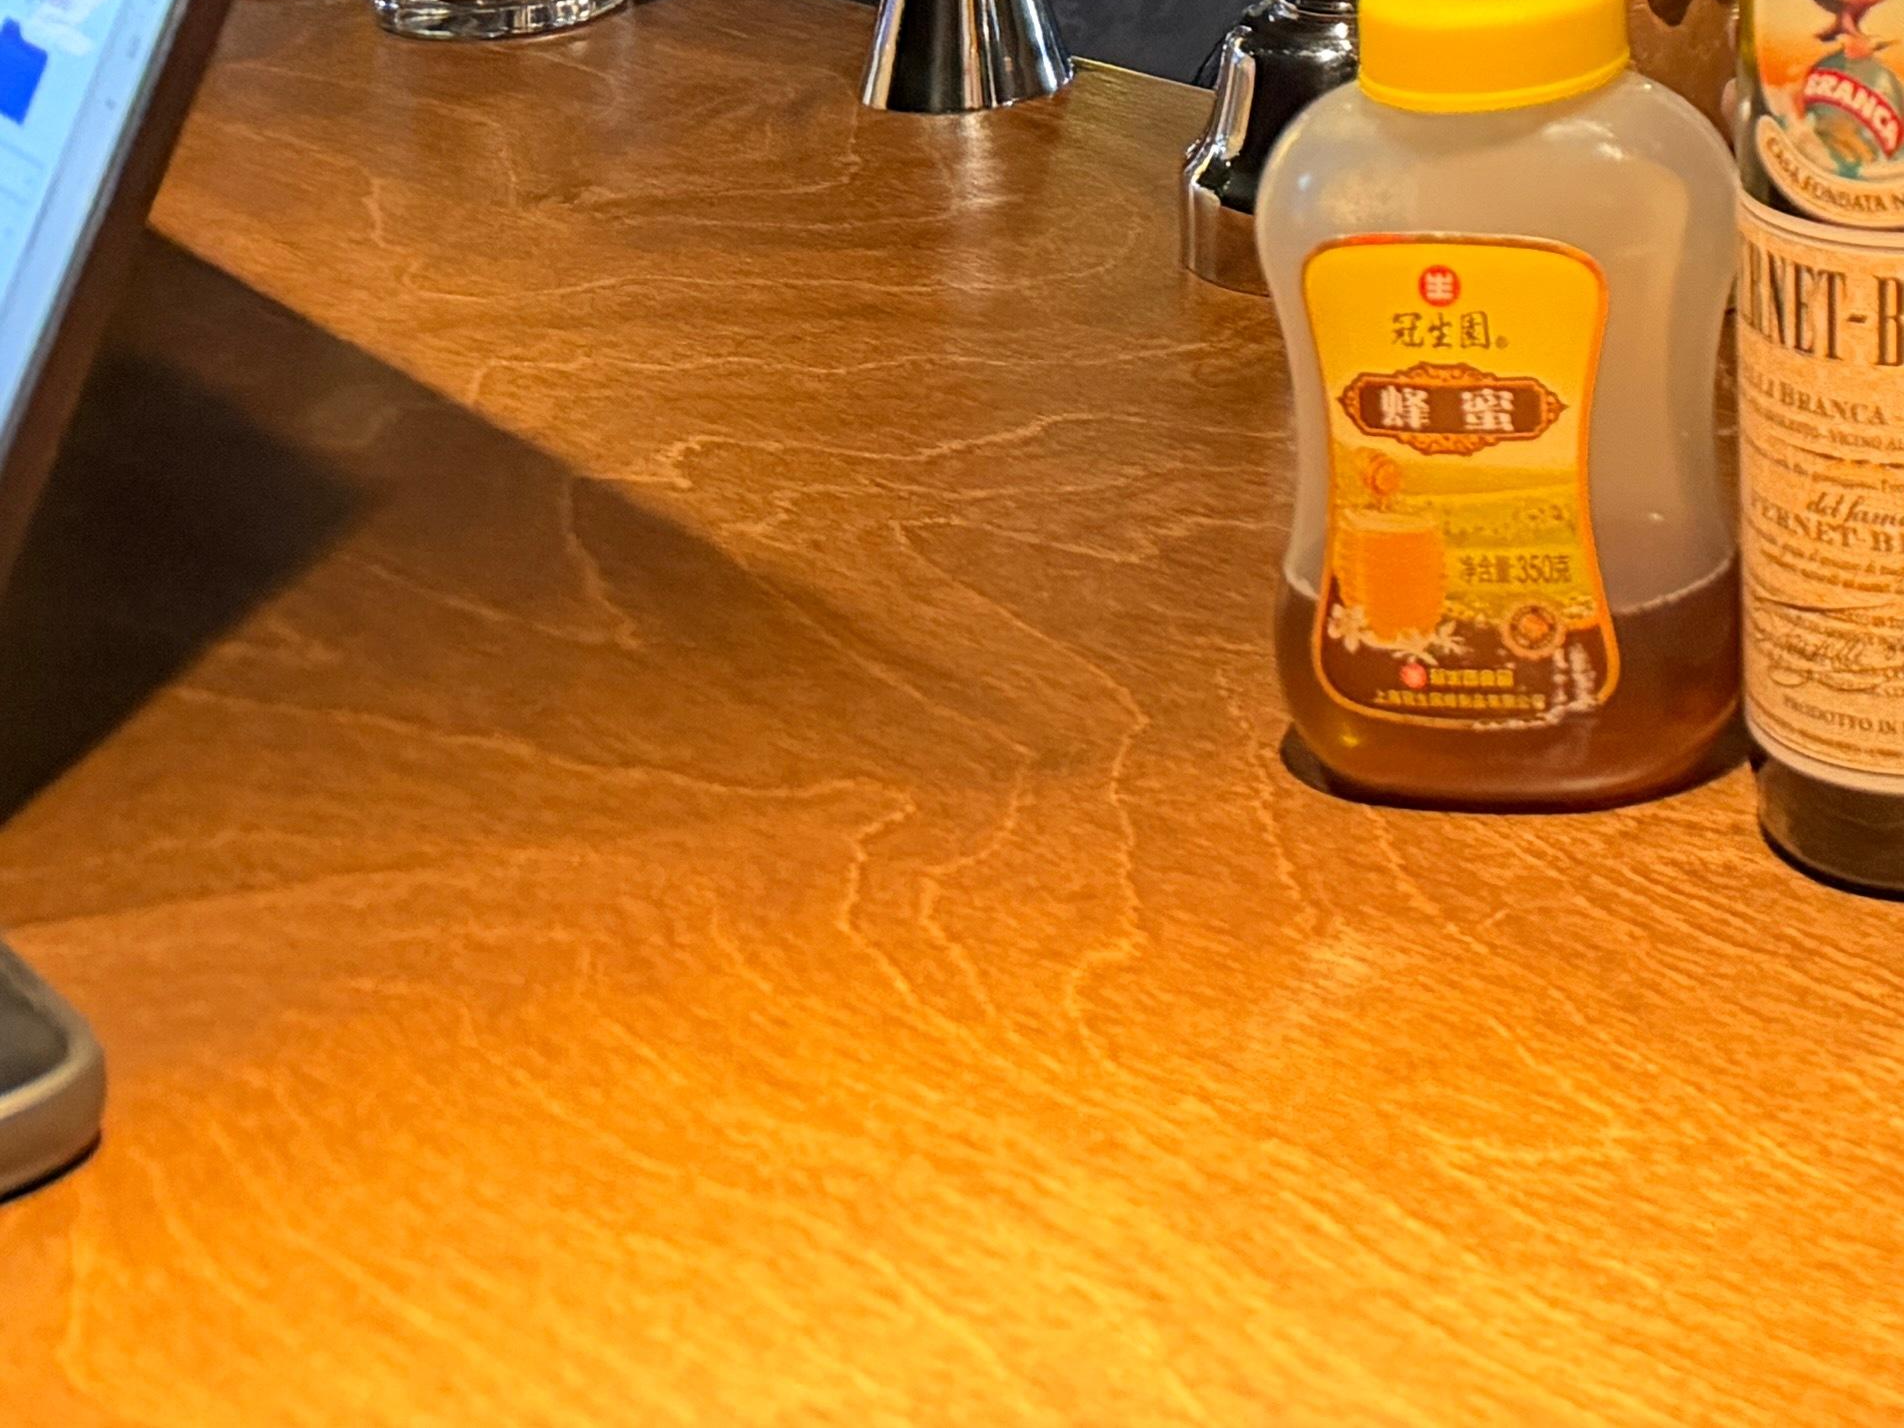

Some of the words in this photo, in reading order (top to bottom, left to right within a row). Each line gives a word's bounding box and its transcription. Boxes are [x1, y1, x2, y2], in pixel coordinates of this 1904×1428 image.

[1804, 70, 1900, 152] BRANCA
[1780, 380, 1888, 427] BRANCA
[1784, 694, 1874, 732] PRODOTTO
[1878, 720, 1897, 736] IN
